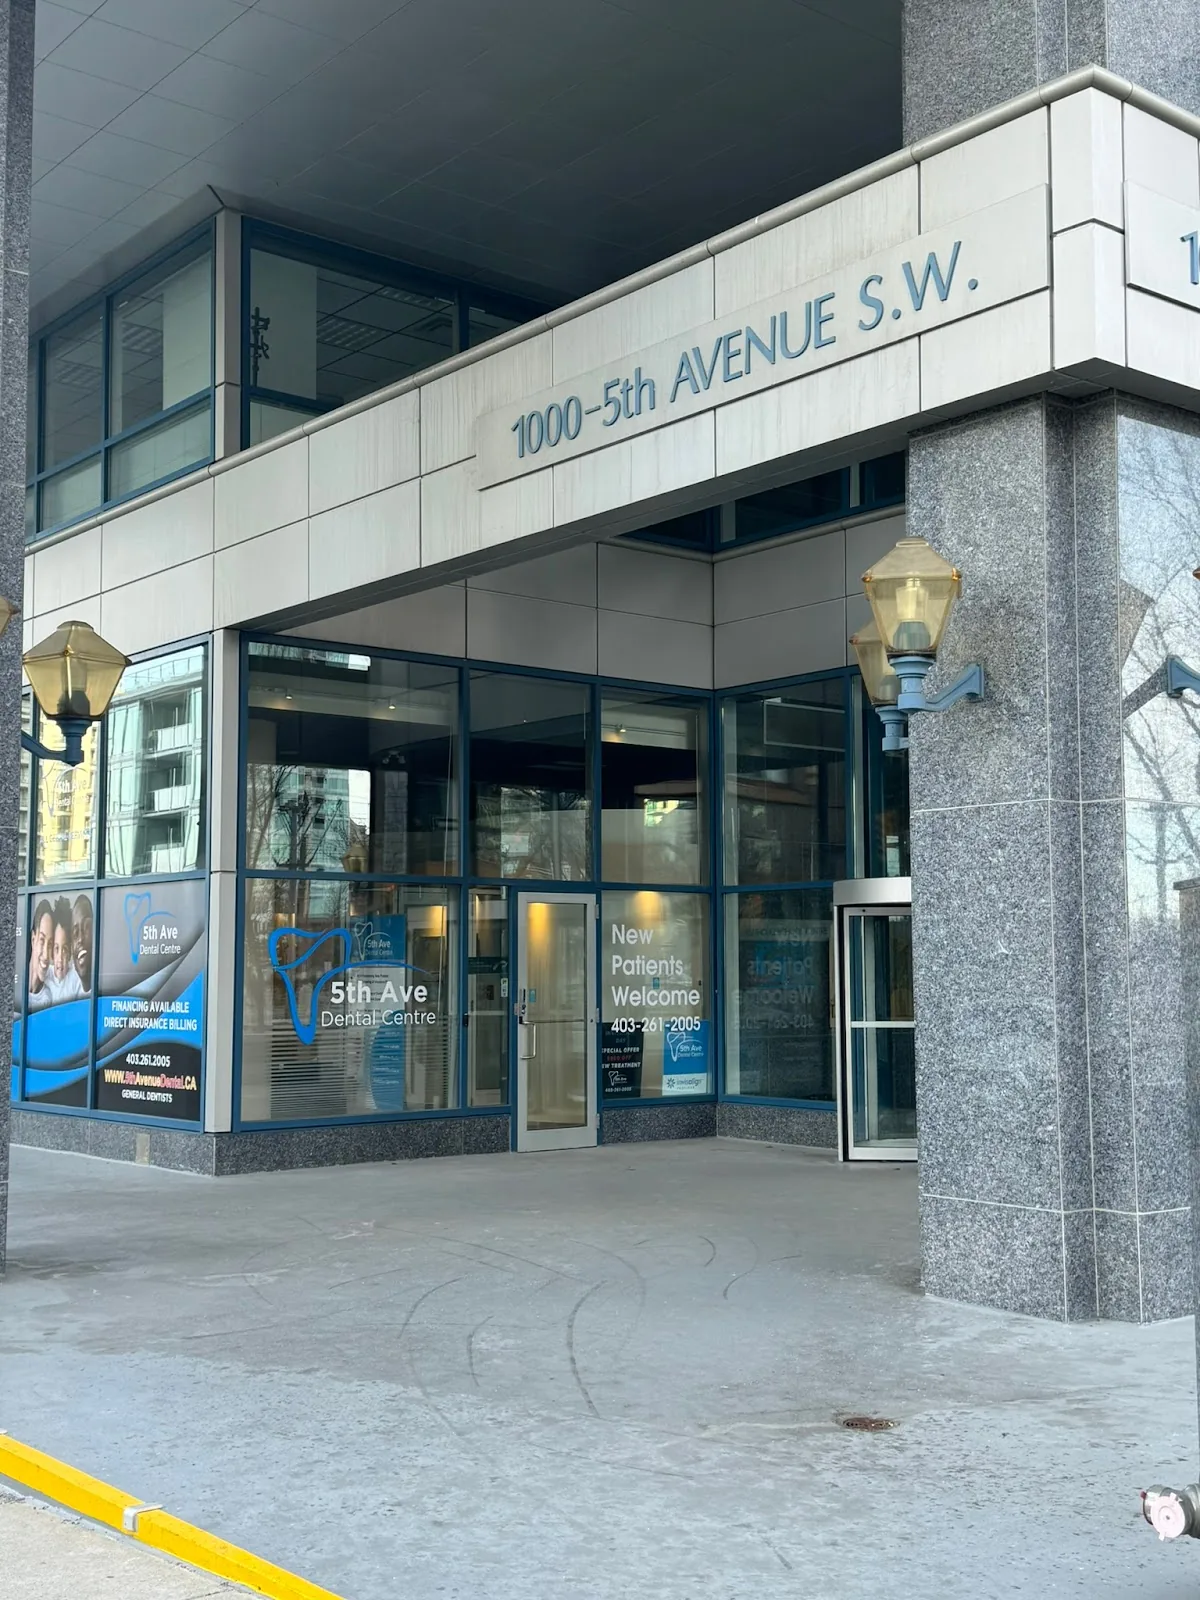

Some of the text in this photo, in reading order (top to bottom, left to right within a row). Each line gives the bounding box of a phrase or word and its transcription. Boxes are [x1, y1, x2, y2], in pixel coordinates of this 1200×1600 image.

[511, 240, 979, 458] 1000-5th AVENUE S.W.
[143, 925, 178, 940] 5th Ave
[611, 923, 654, 945] New
[140, 943, 181, 954] Dental Centre
[612, 955, 683, 976] Patients
[330, 980, 371, 1004] 5th
[380, 980, 428, 1003] Ave
[611, 985, 700, 1006] Welcome
[111, 1000, 190, 1013] FINANCING AVAILABLE
[104, 1016, 198, 1031] DIRECT INSURANCE BILLING
[321, 1009, 436, 1027] Dental Centre
[611, 1016, 701, 1033] 403-261-2005
[126, 1053, 171, 1067] 403.261.2005
[611, 1061, 641, 1069] TREATMENT
[121, 1089, 173, 1103] GENERAL DENTISTS
